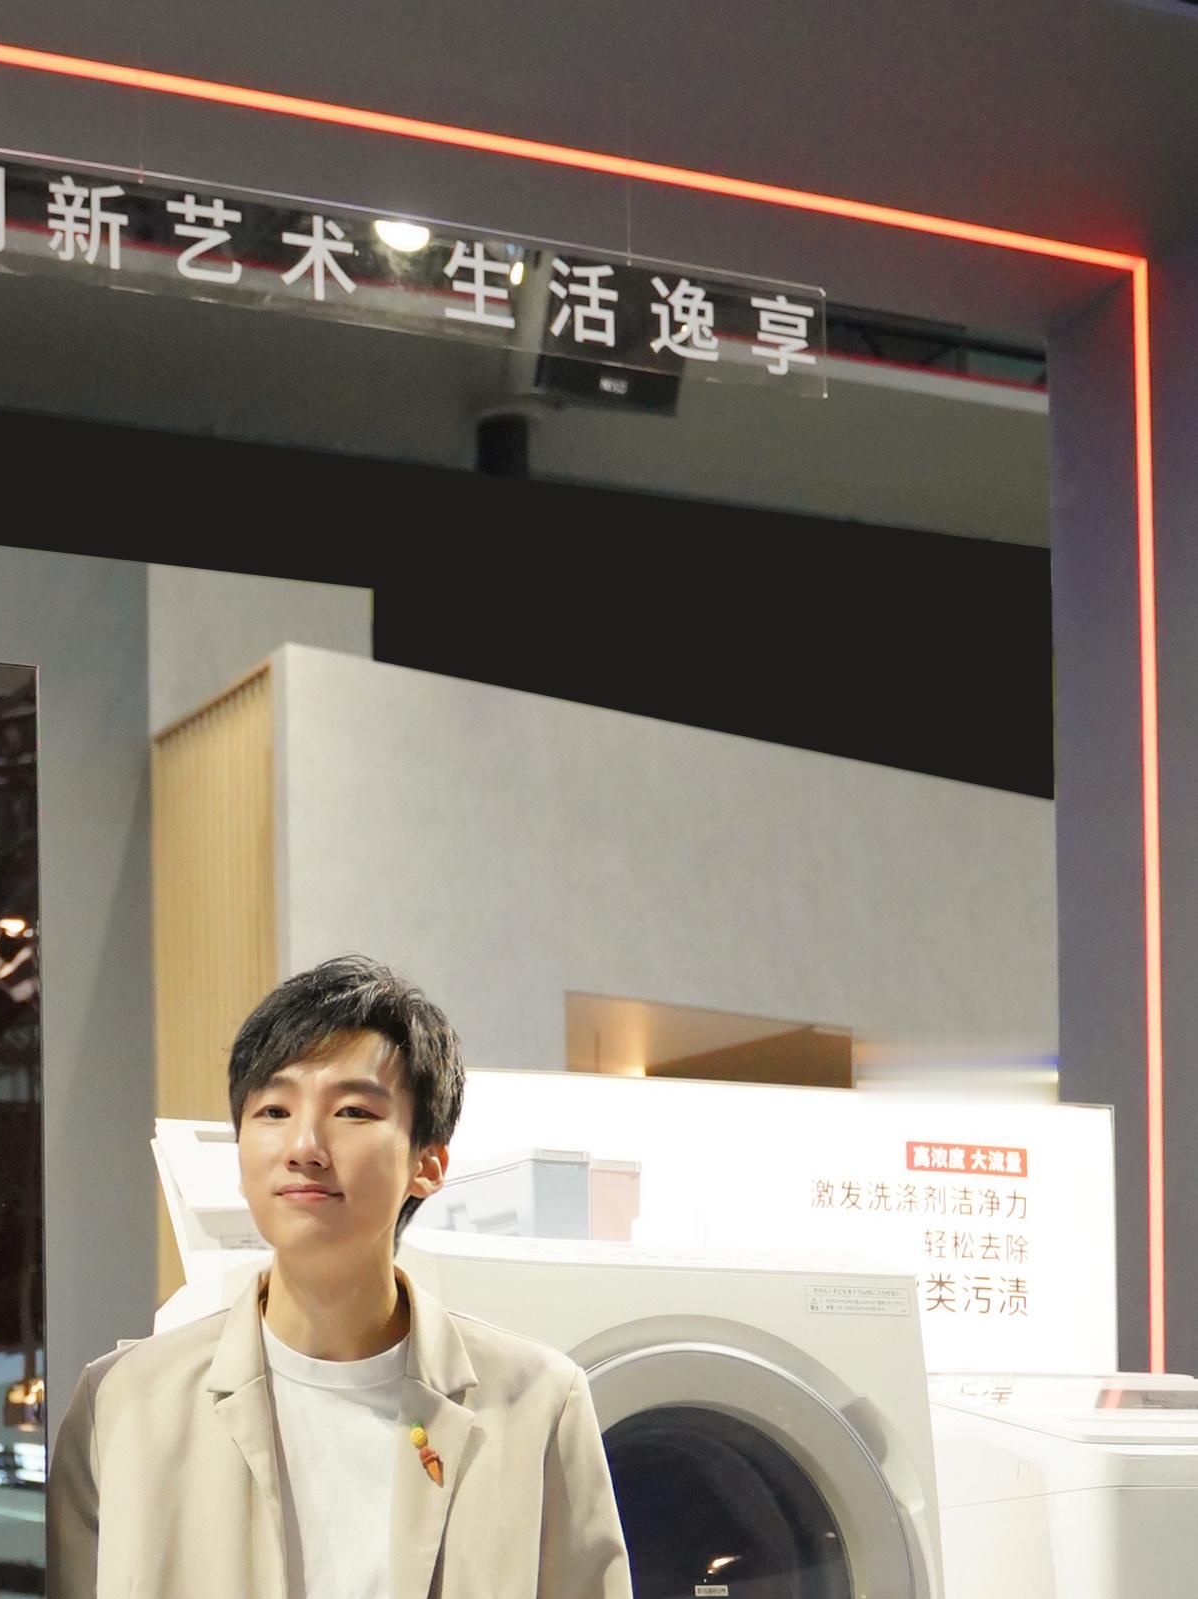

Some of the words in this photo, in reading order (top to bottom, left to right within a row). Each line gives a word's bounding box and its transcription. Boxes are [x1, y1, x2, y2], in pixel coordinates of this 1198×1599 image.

[443, 242, 817, 375] 生活逸享
[811, 1179, 1027, 1219] 激发洗涤剂洁净力
[924, 1229, 1028, 1263] 轻松去除
[915, 1272, 1029, 1316] 类污渍
